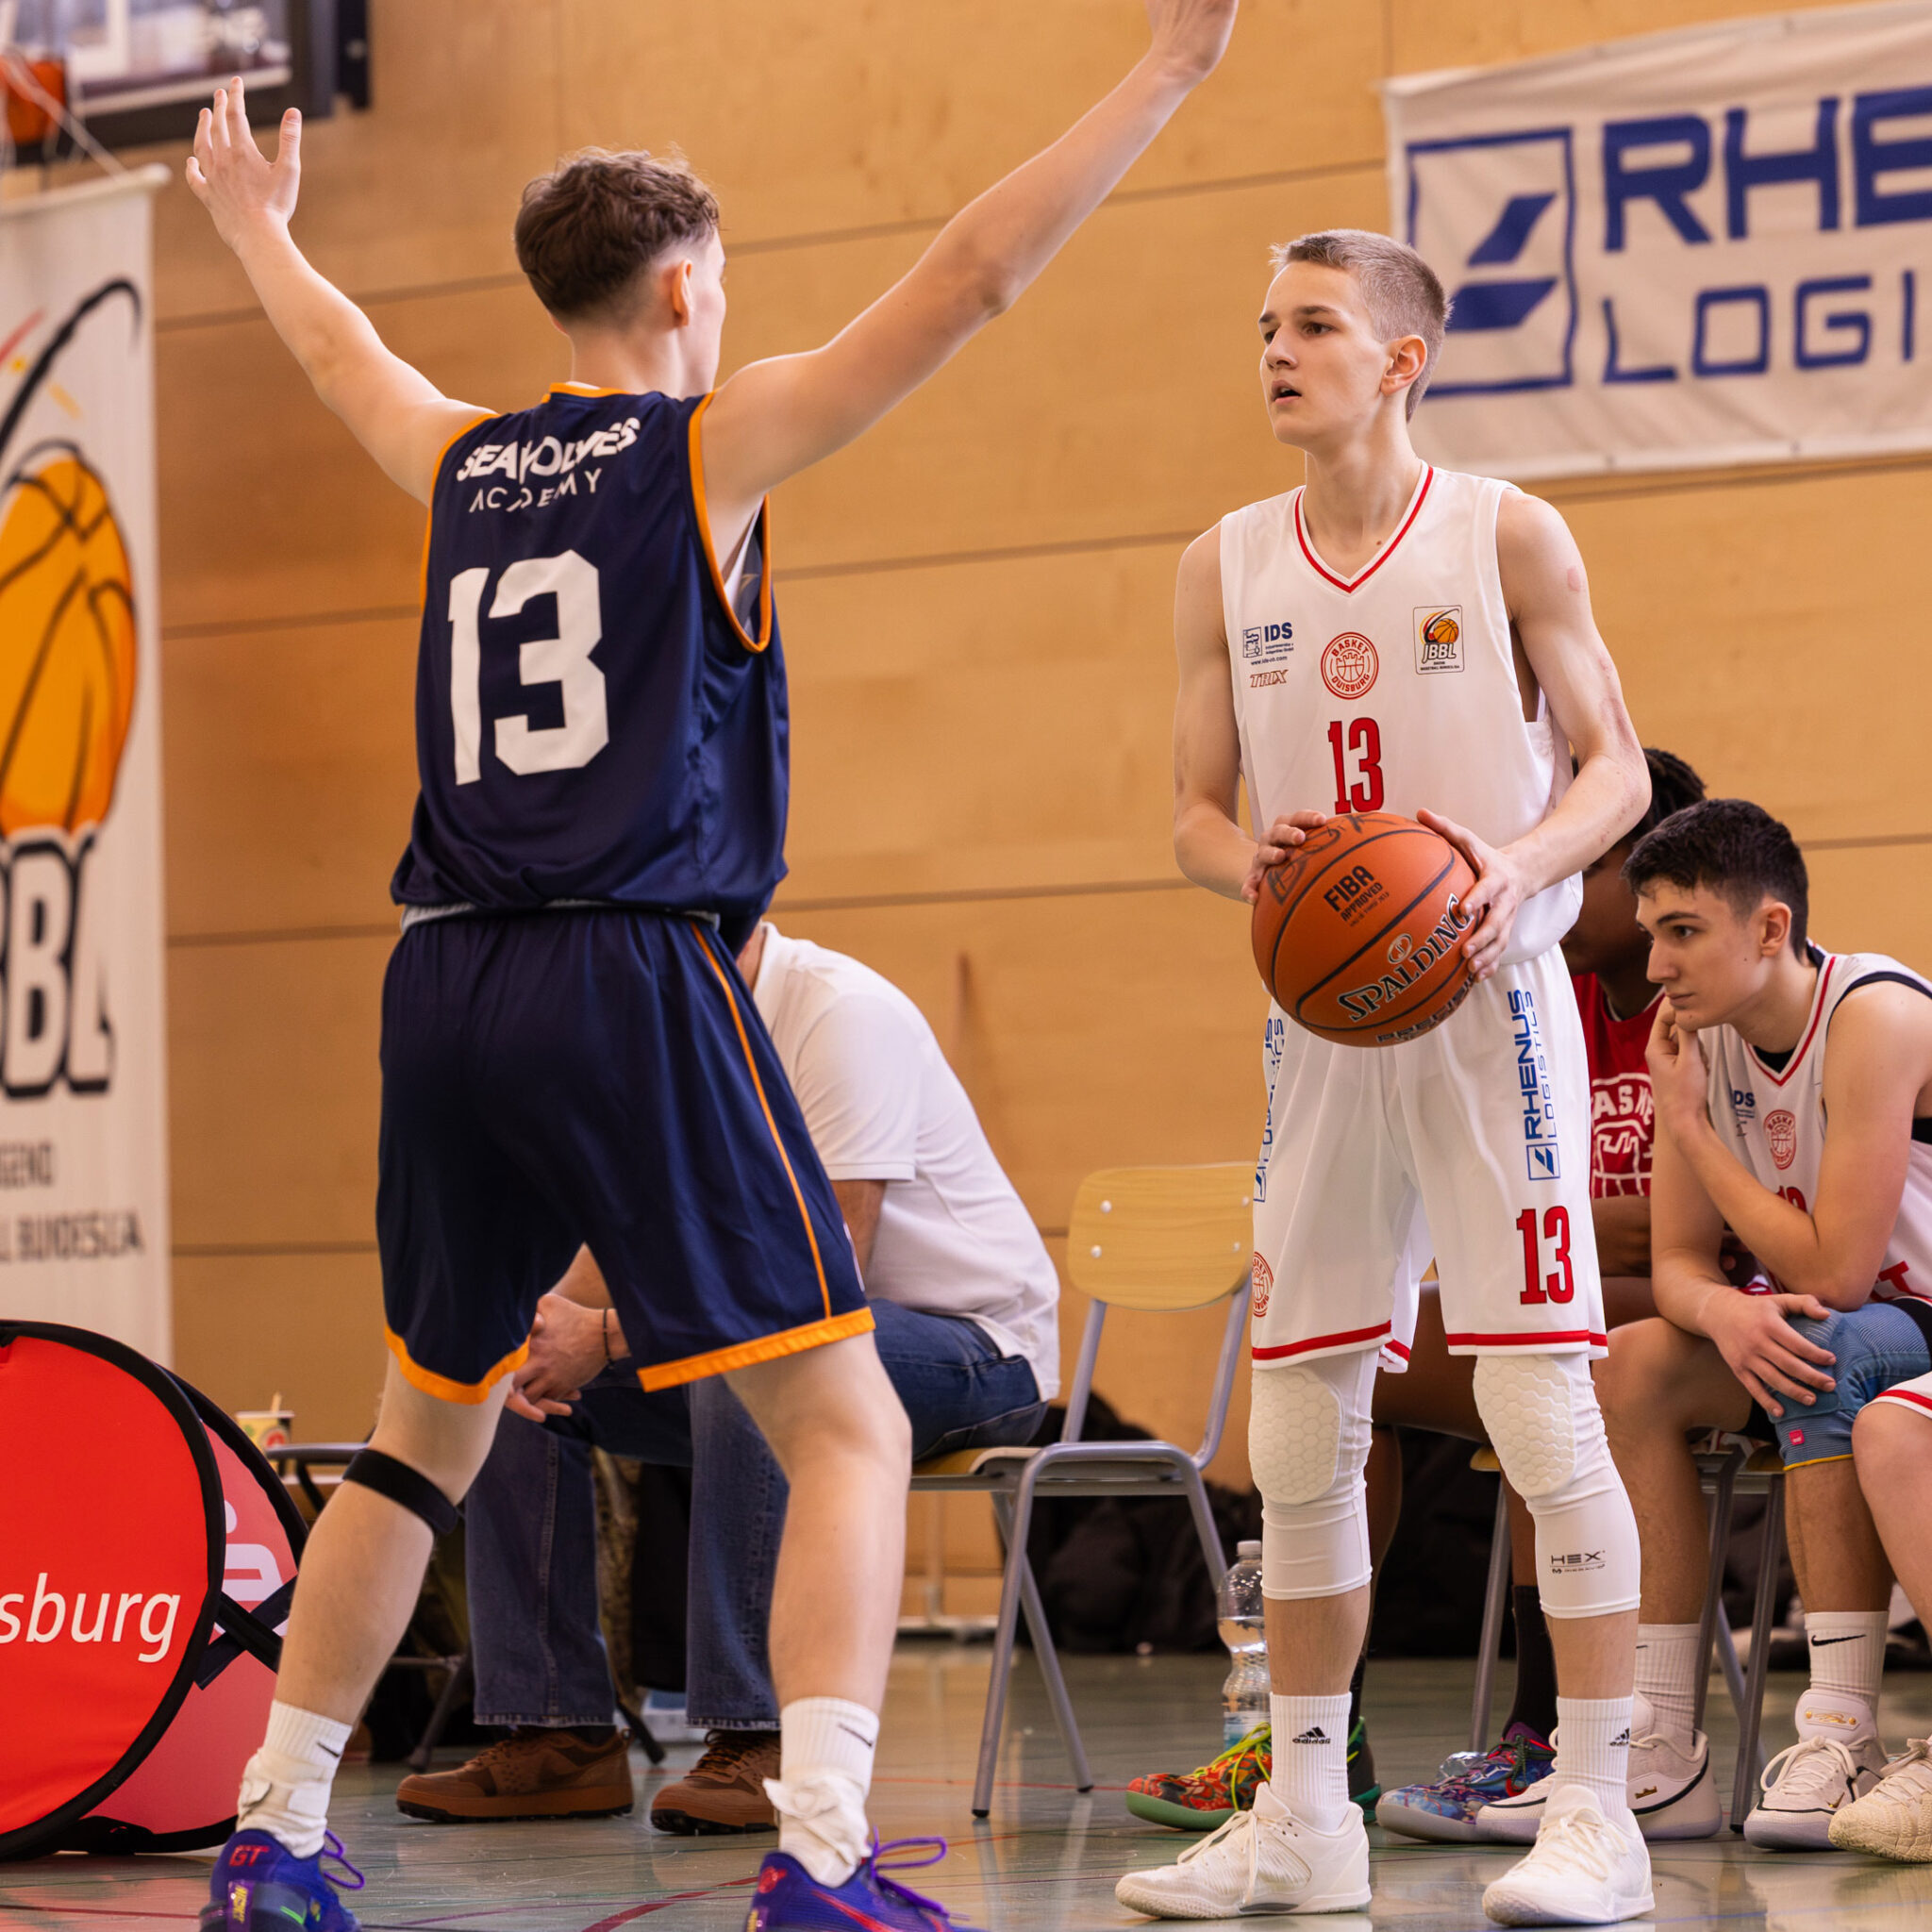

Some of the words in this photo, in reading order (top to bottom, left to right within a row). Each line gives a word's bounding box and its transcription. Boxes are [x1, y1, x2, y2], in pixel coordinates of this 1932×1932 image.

[1602, 85, 1932, 252] RHE
[1602, 270, 1915, 384] LOGI
[1264, 622, 1293, 642] IDS
[1331, 639, 1370, 658] BASKET
[447, 548, 609, 786] 13
[1250, 669, 1290, 688] TRIX
[1331, 673, 1371, 691] DUISBURG
[1327, 717, 1385, 815] 13
[1323, 865, 1374, 911] FIBA
[1340, 881, 1384, 923] APPROVED
[0, 833, 114, 1100] BL
[1338, 892, 1474, 1023] SPALDING
[1507, 989, 1543, 1141] RHENUS
[1523, 991, 1557, 1139] LOGISTICS
[1734, 1090, 1756, 1108] DS
[1767, 1115, 1793, 1131] BASKE
[1515, 1205, 1575, 1306] 13
[1551, 1552, 1601, 1565] HEX
[0, 1573, 180, 1664] sburg
[229, 1844, 270, 1867] GT
